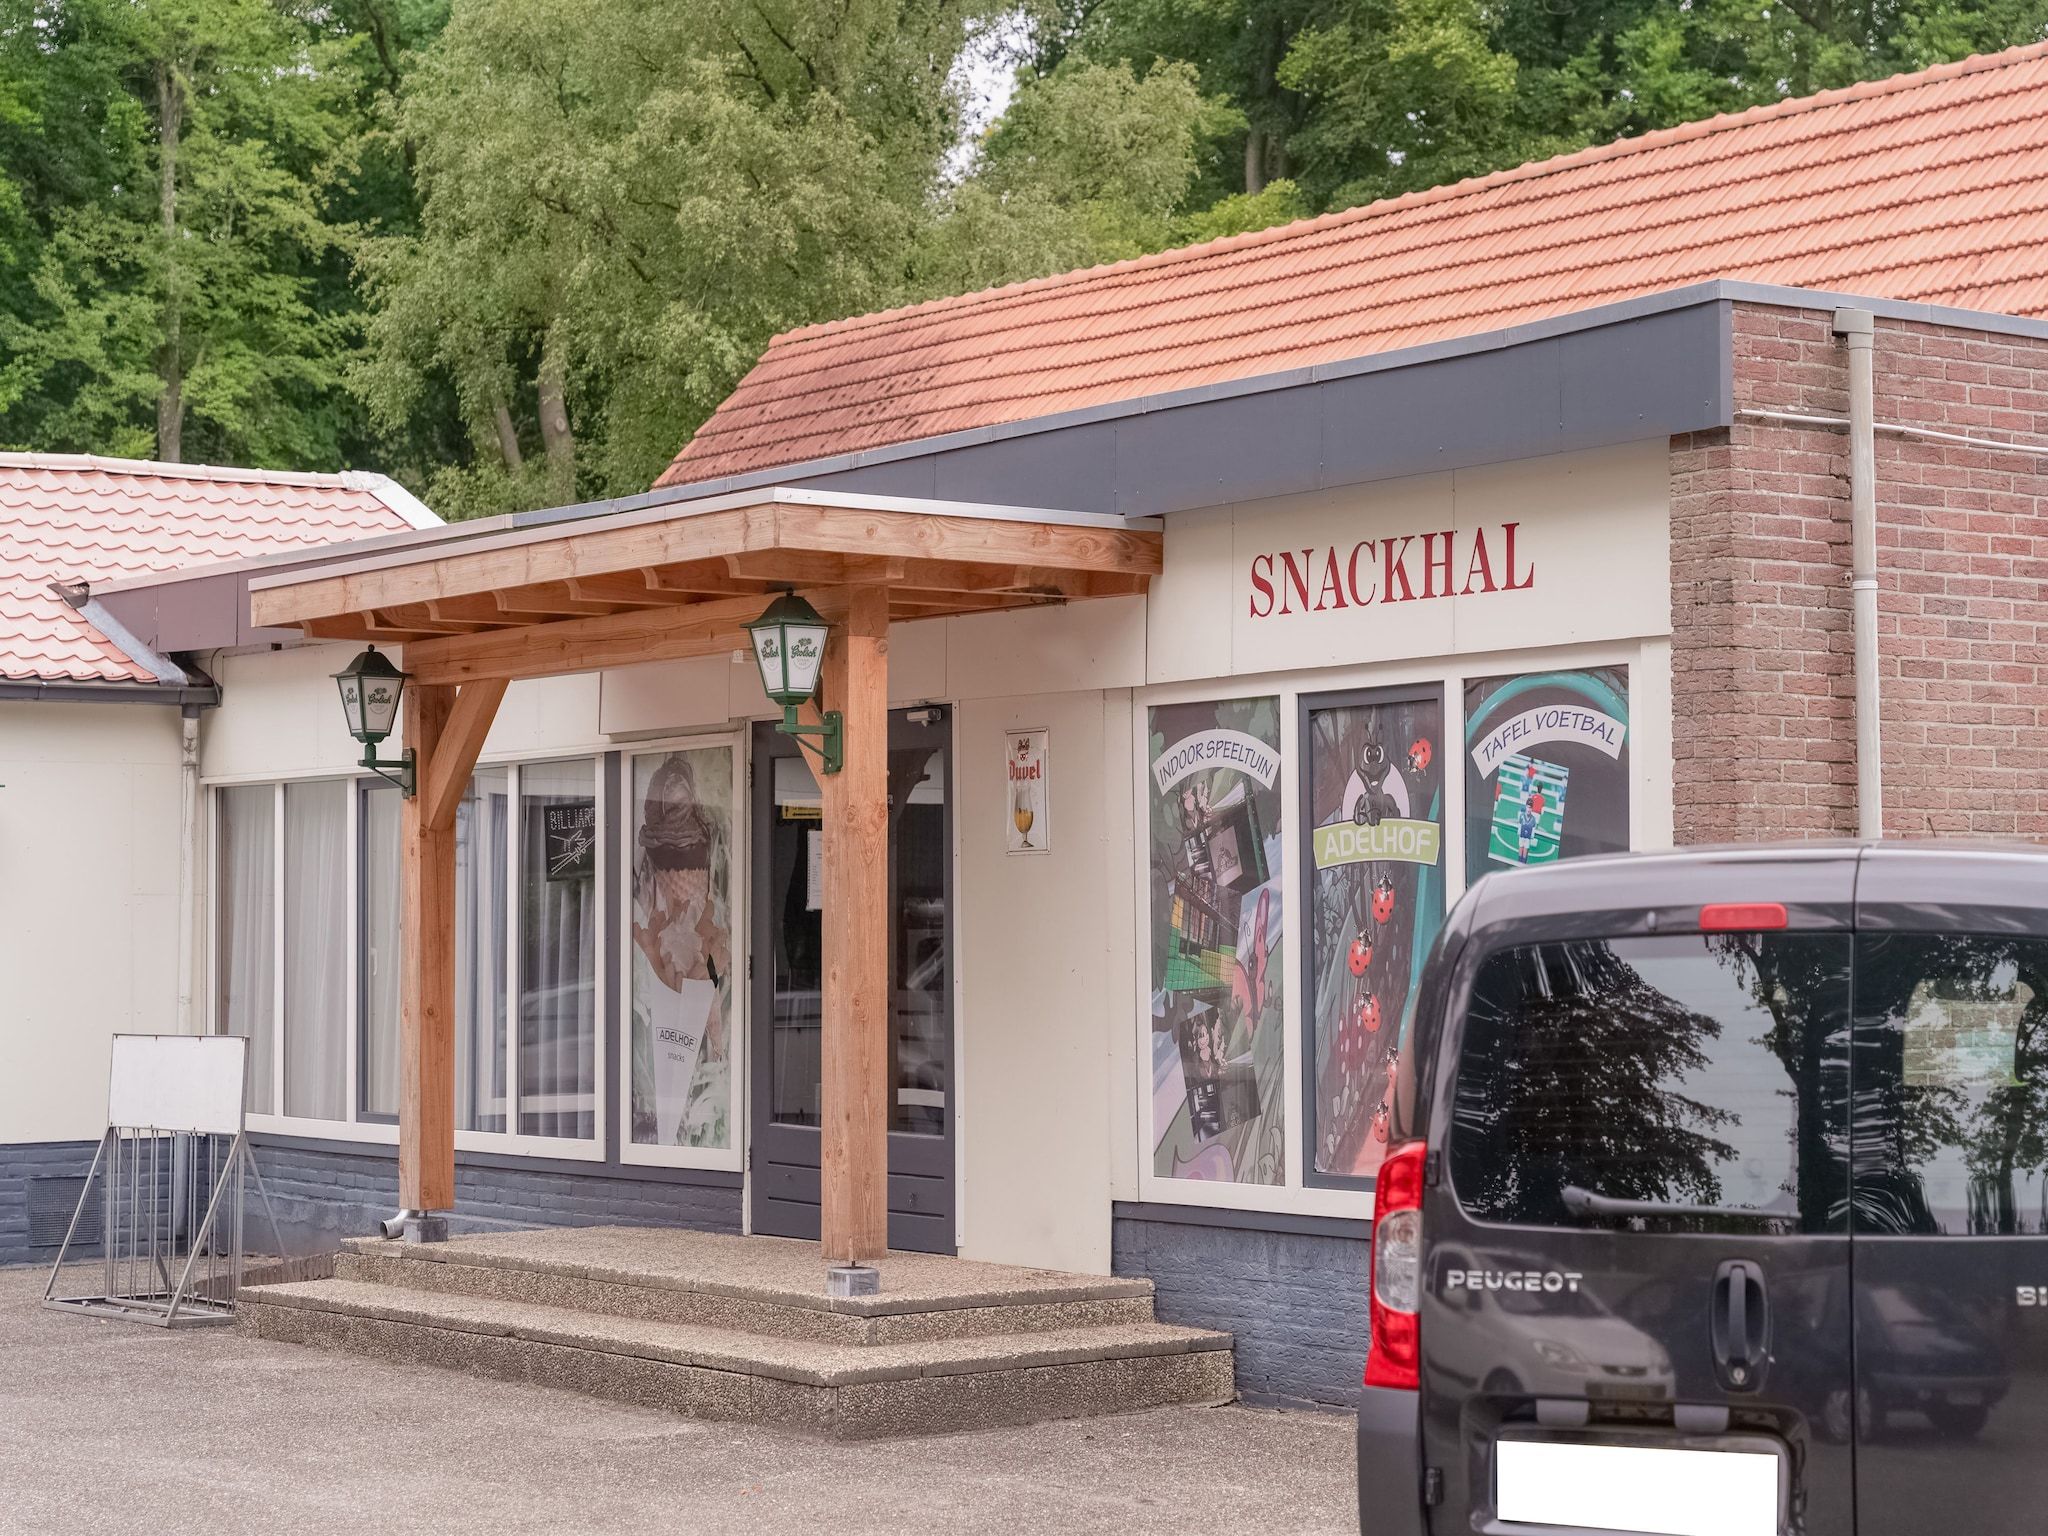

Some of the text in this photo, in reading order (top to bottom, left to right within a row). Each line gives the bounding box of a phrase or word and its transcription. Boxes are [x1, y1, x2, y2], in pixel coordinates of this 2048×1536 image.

[1250, 522, 1534, 618] SNACKHAL
[1482, 710, 1619, 762] TAFEL VOETBAL
[1008, 759, 1041, 781] Duvel
[1159, 740, 1273, 786] INDOOR SPEELTUIN
[1324, 826, 1432, 861] ADELHOF
[659, 1029, 695, 1048] ADELHOF
[667, 1051, 685, 1063] snacks
[1447, 1269, 1583, 1293] PEUGEOT
